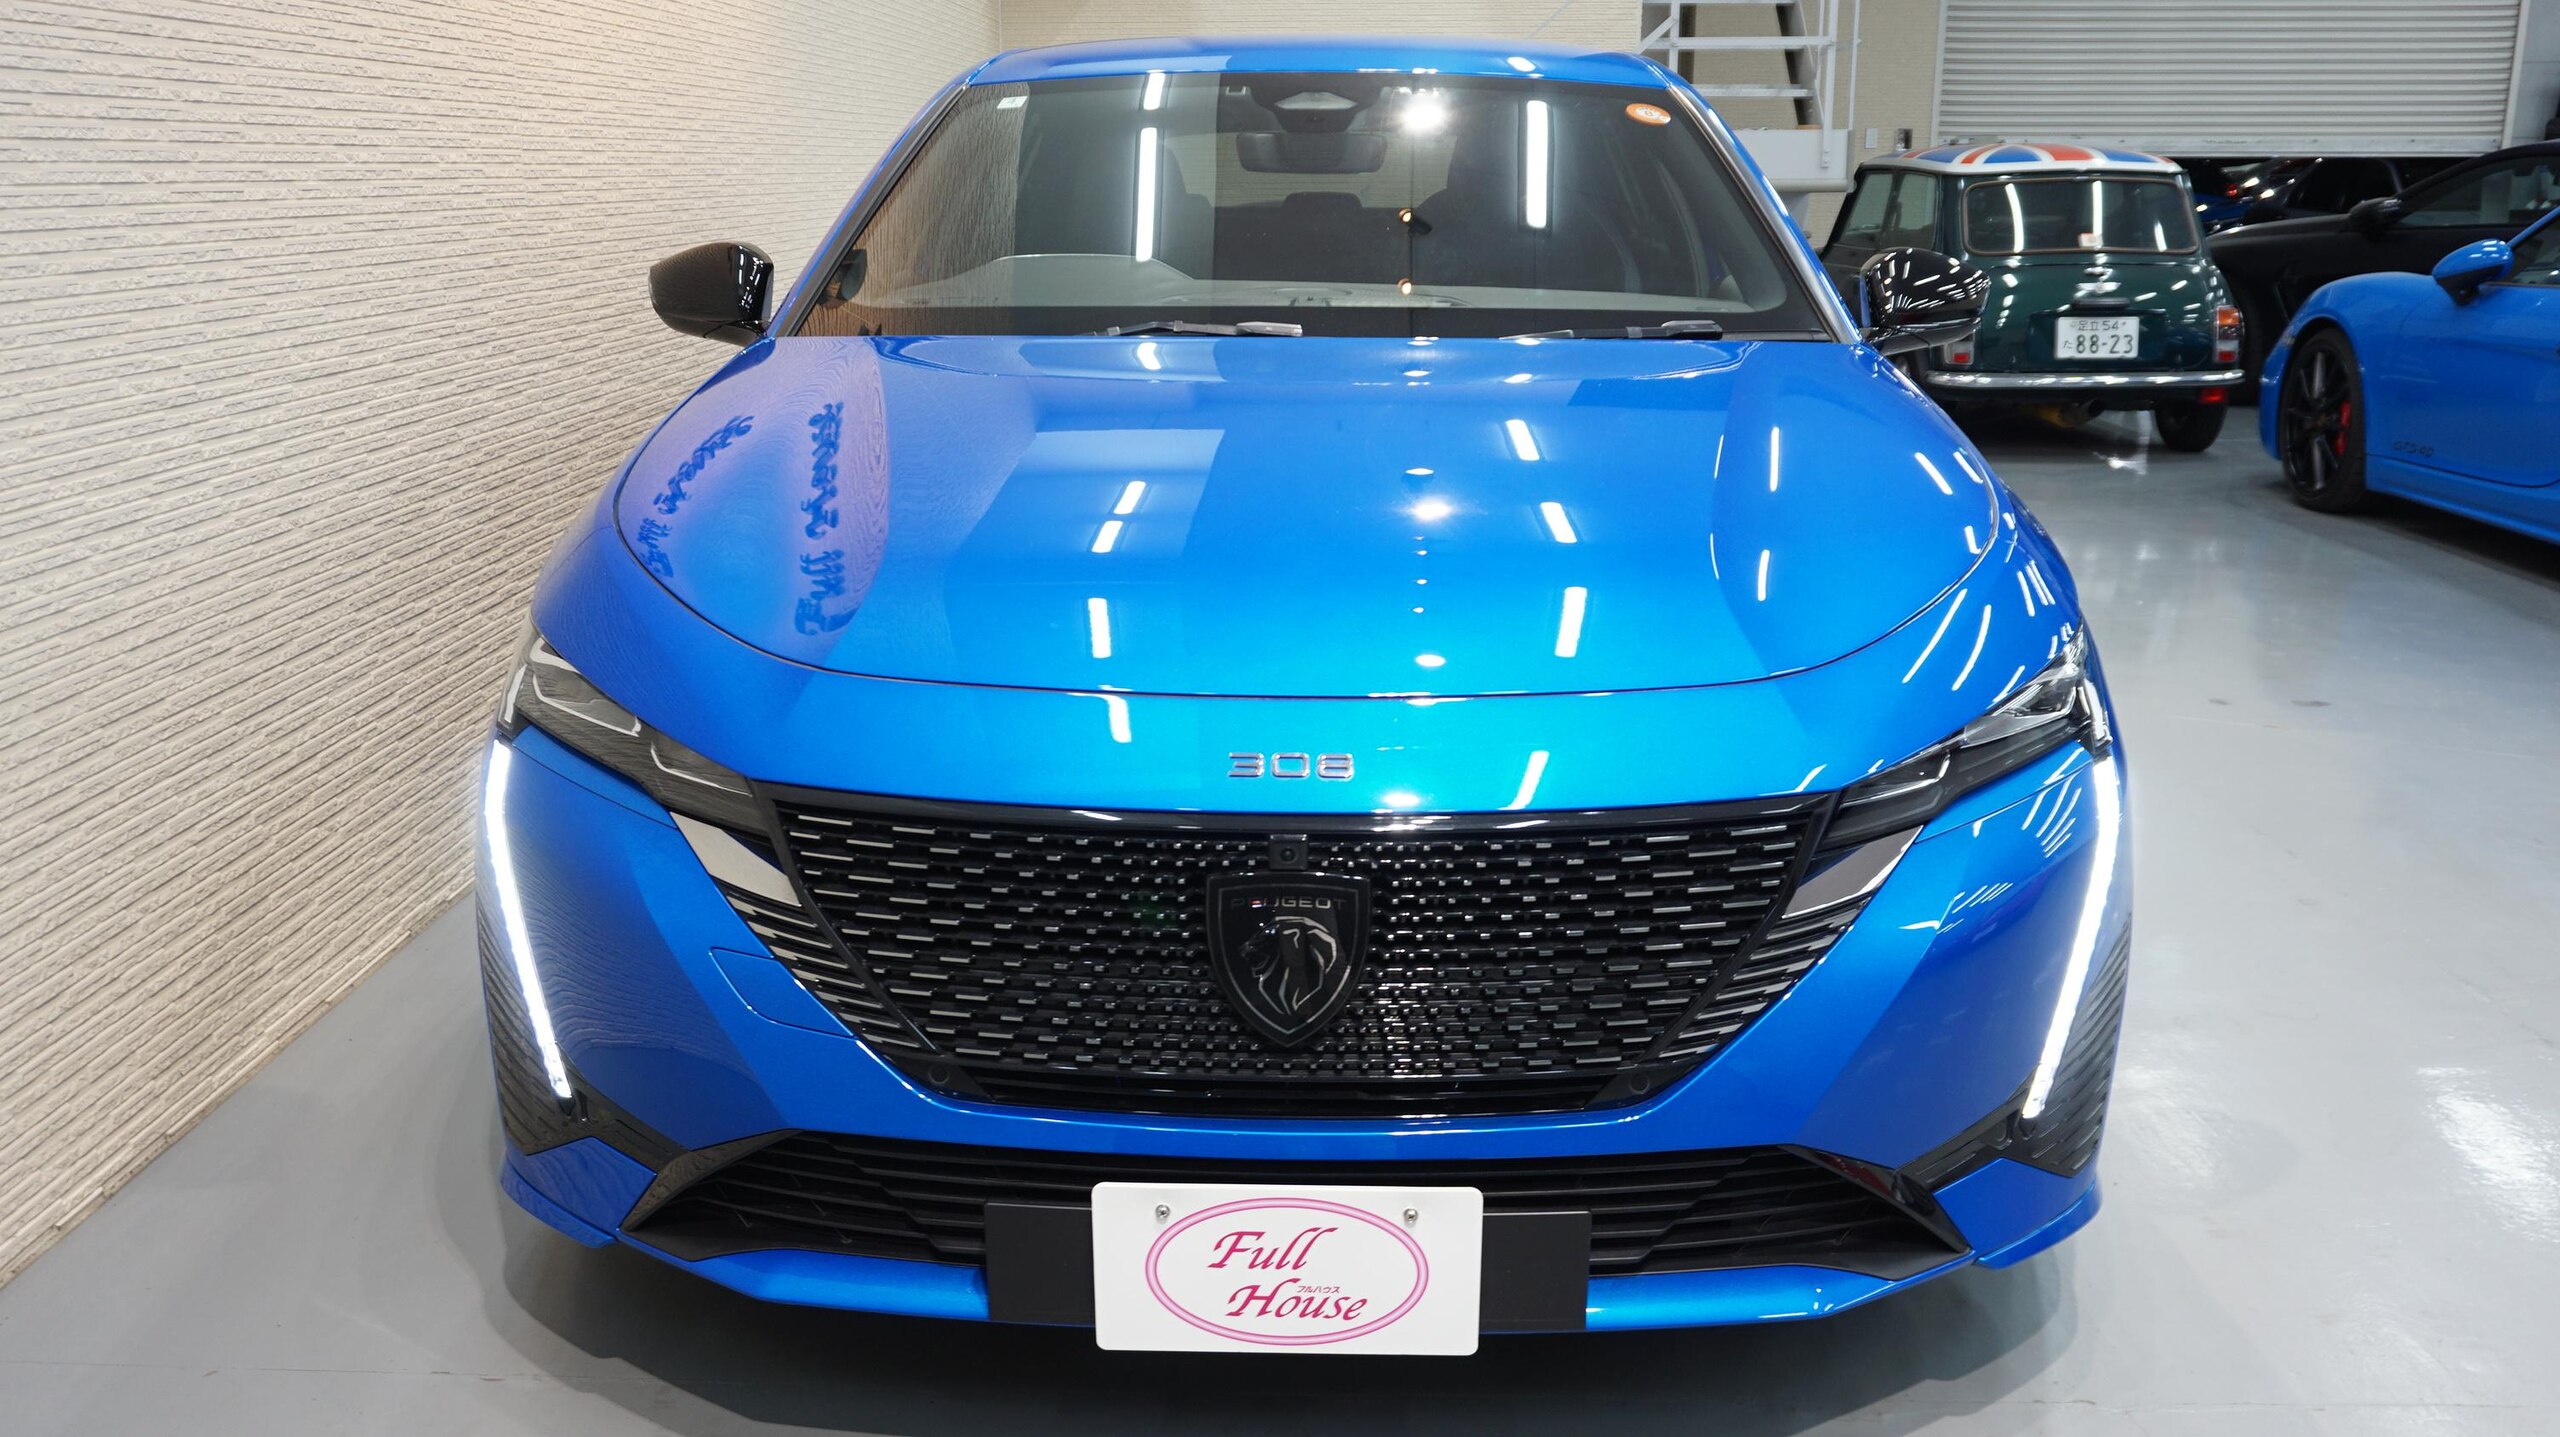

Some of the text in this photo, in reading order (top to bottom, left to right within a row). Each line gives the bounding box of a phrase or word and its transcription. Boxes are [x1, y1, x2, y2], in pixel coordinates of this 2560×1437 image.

[2102, 320, 2119, 331] 54
[2076, 334, 2133, 354] 88-23
[1229, 752, 1355, 779] 308
[1230, 895, 1347, 909] PEUGEOT
[1207, 1227, 1339, 1270] Full
[1225, 1277, 1368, 1321] House
[1296, 1285, 1341, 1294] フルハウス
